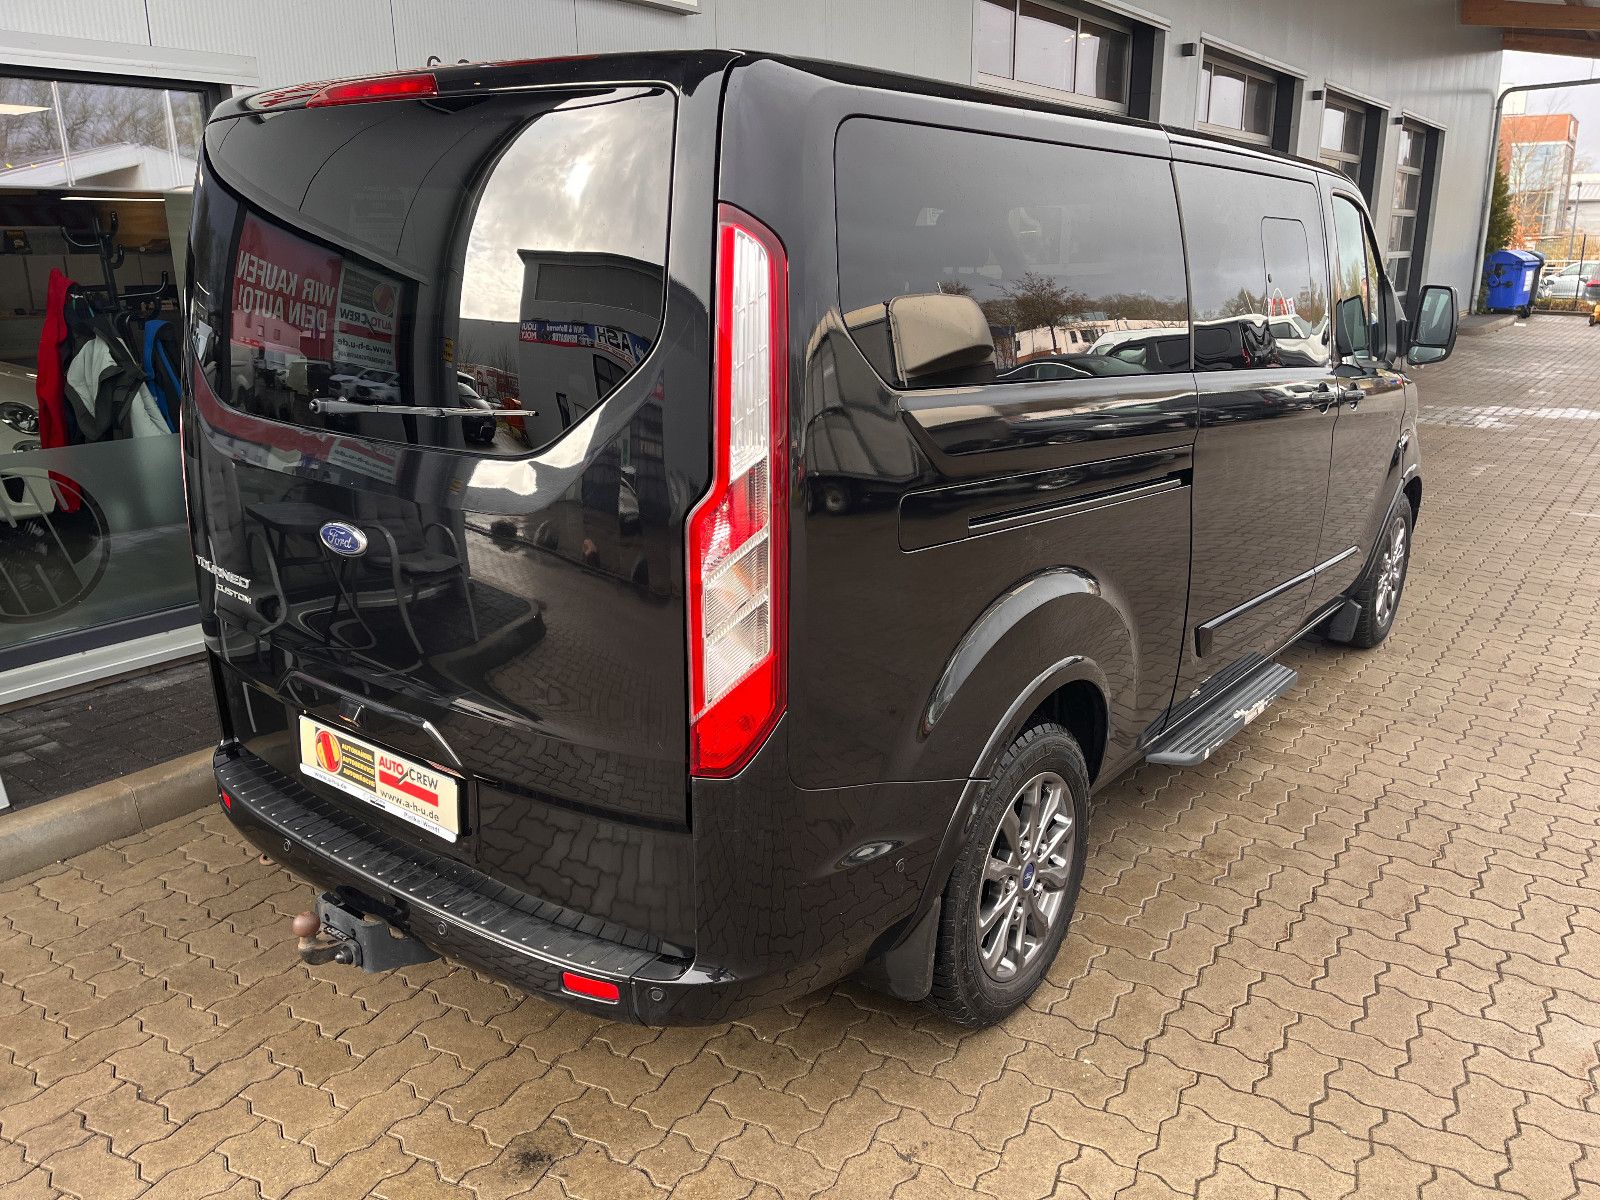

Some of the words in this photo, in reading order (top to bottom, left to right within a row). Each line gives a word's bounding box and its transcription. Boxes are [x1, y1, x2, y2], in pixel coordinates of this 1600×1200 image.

[327, 528, 352, 549] Ford
[215, 583, 252, 605] CUSTOM
[379, 755, 404, 776] AUTO
[408, 768, 439, 790] CREW
[380, 790, 440, 822] www.a-h-u.de
